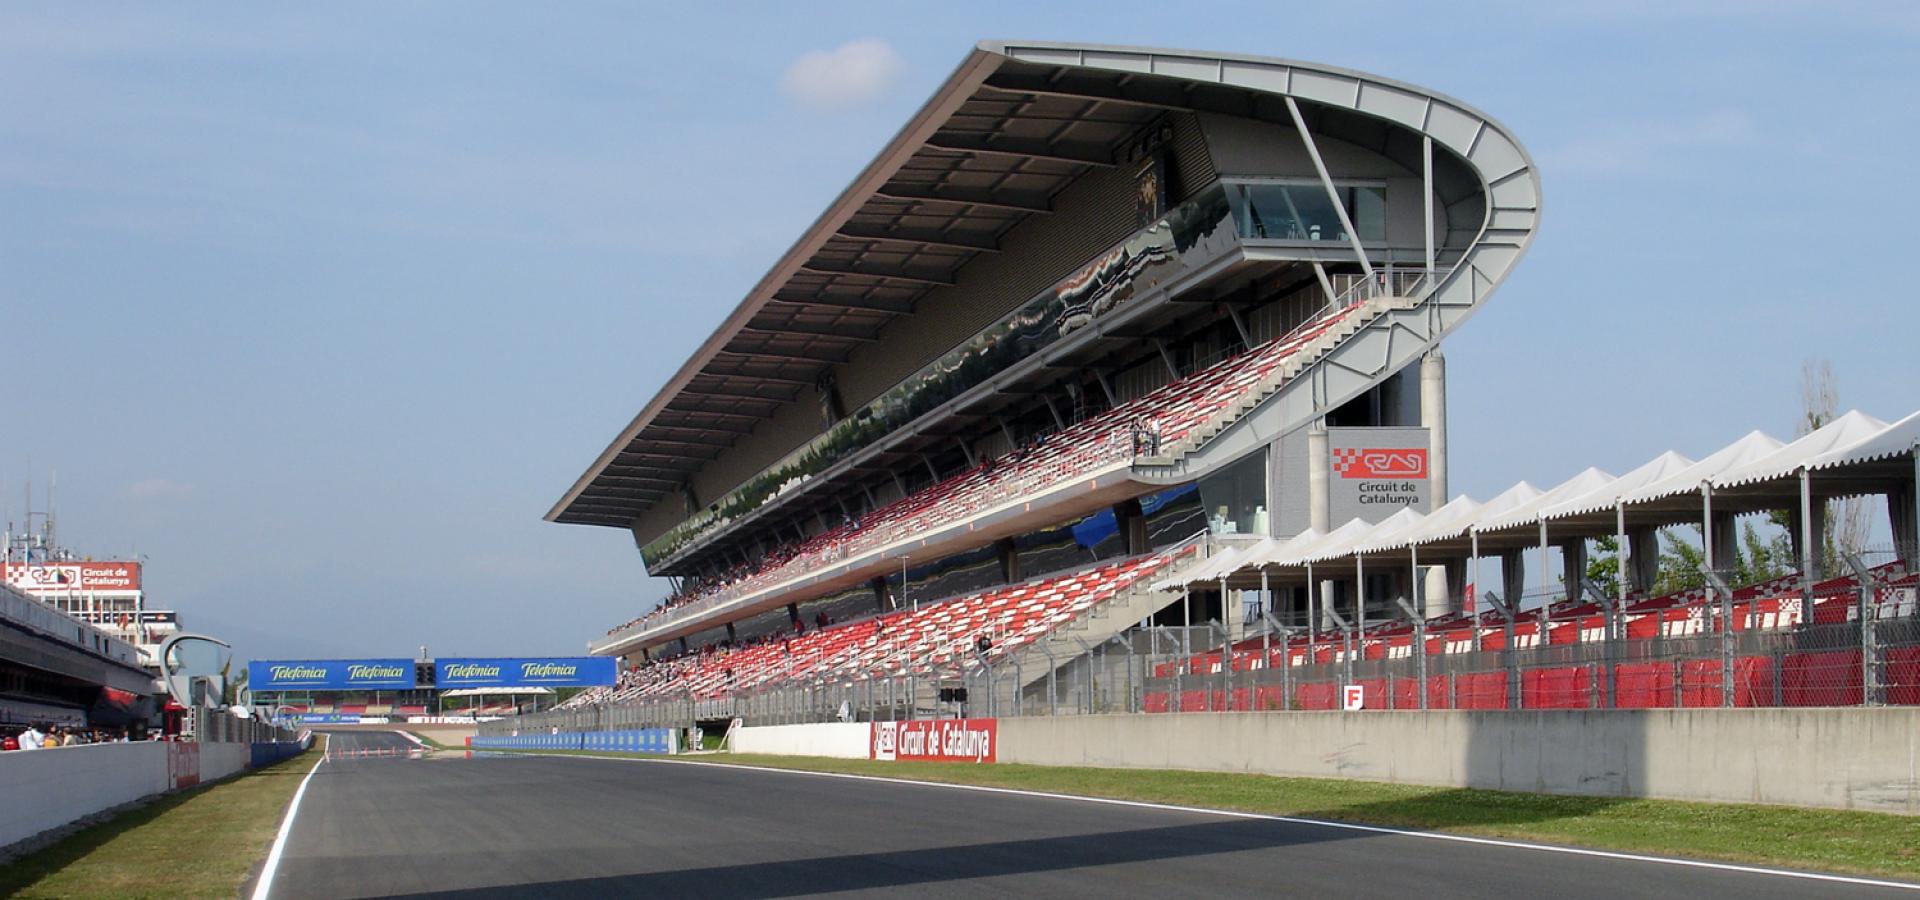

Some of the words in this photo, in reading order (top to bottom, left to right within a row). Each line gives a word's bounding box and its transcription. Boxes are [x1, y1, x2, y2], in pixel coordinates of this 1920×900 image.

[1358, 481, 1397, 492] Circuit
[1401, 481, 1416, 492] de
[1359, 493, 1419, 506] Catalunya
[82, 568, 114, 577] Circuit
[115, 567, 128, 577] de
[82, 577, 130, 586] Catalunya
[1348, 690, 1360, 706] F
[899, 721, 925, 756] Circuit
[927, 720, 939, 756] de
[942, 719, 990, 764] Catalunya
